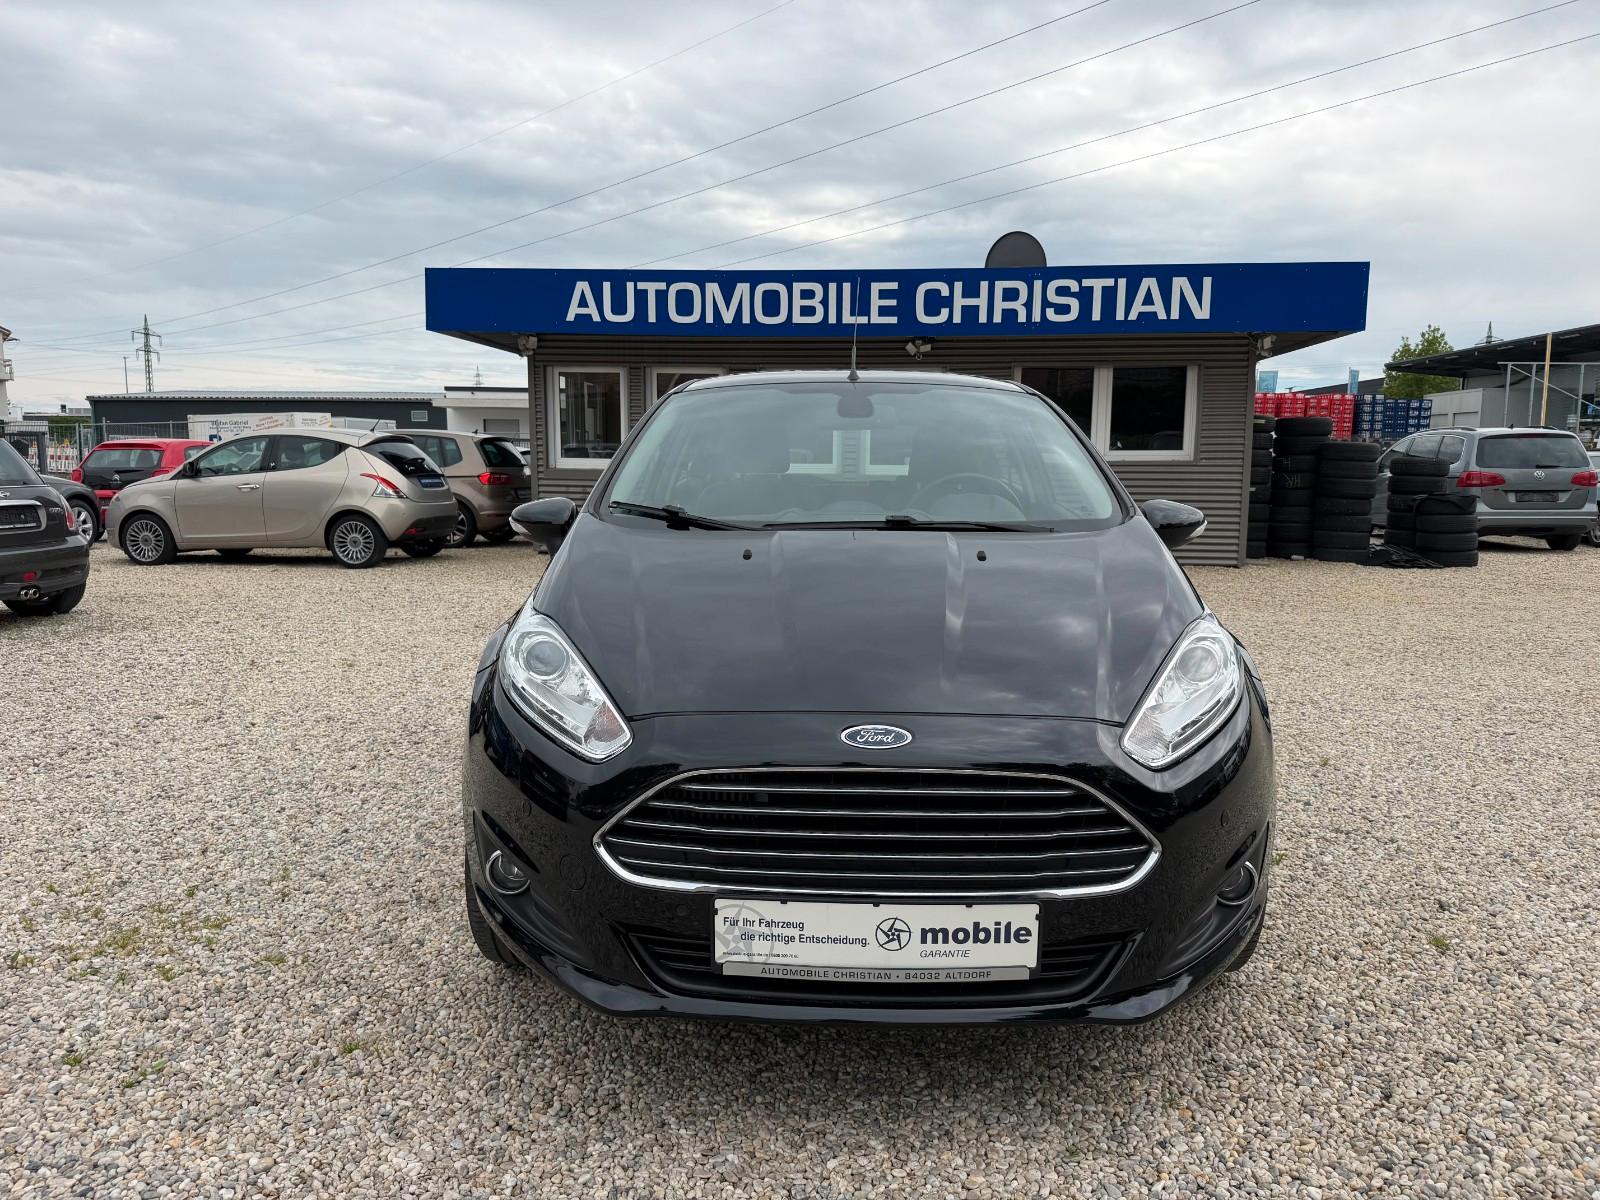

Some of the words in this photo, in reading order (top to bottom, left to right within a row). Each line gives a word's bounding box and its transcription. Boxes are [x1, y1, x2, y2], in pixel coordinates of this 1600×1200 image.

[565, 281, 899, 325] AUTOMOBILE
[915, 276, 1212, 325] CHRISTIAN
[856, 729, 896, 743] Ford
[723, 916, 740, 927] Für
[742, 917, 756, 928] Ihr
[758, 918, 805, 931] Fahrzeug
[740, 931, 756, 942] die
[758, 932, 796, 945] richtige
[799, 933, 870, 948] Entscheidung.
[920, 921, 1033, 945] mobile
[920, 949, 971, 958] GARANTIE
[760, 967, 830, 978] AUTOMOBILE
[833, 971, 892, 980] CHRISTIAN
[904, 972, 941, 980] 84032
[944, 970, 993, 980] ALTDORF
